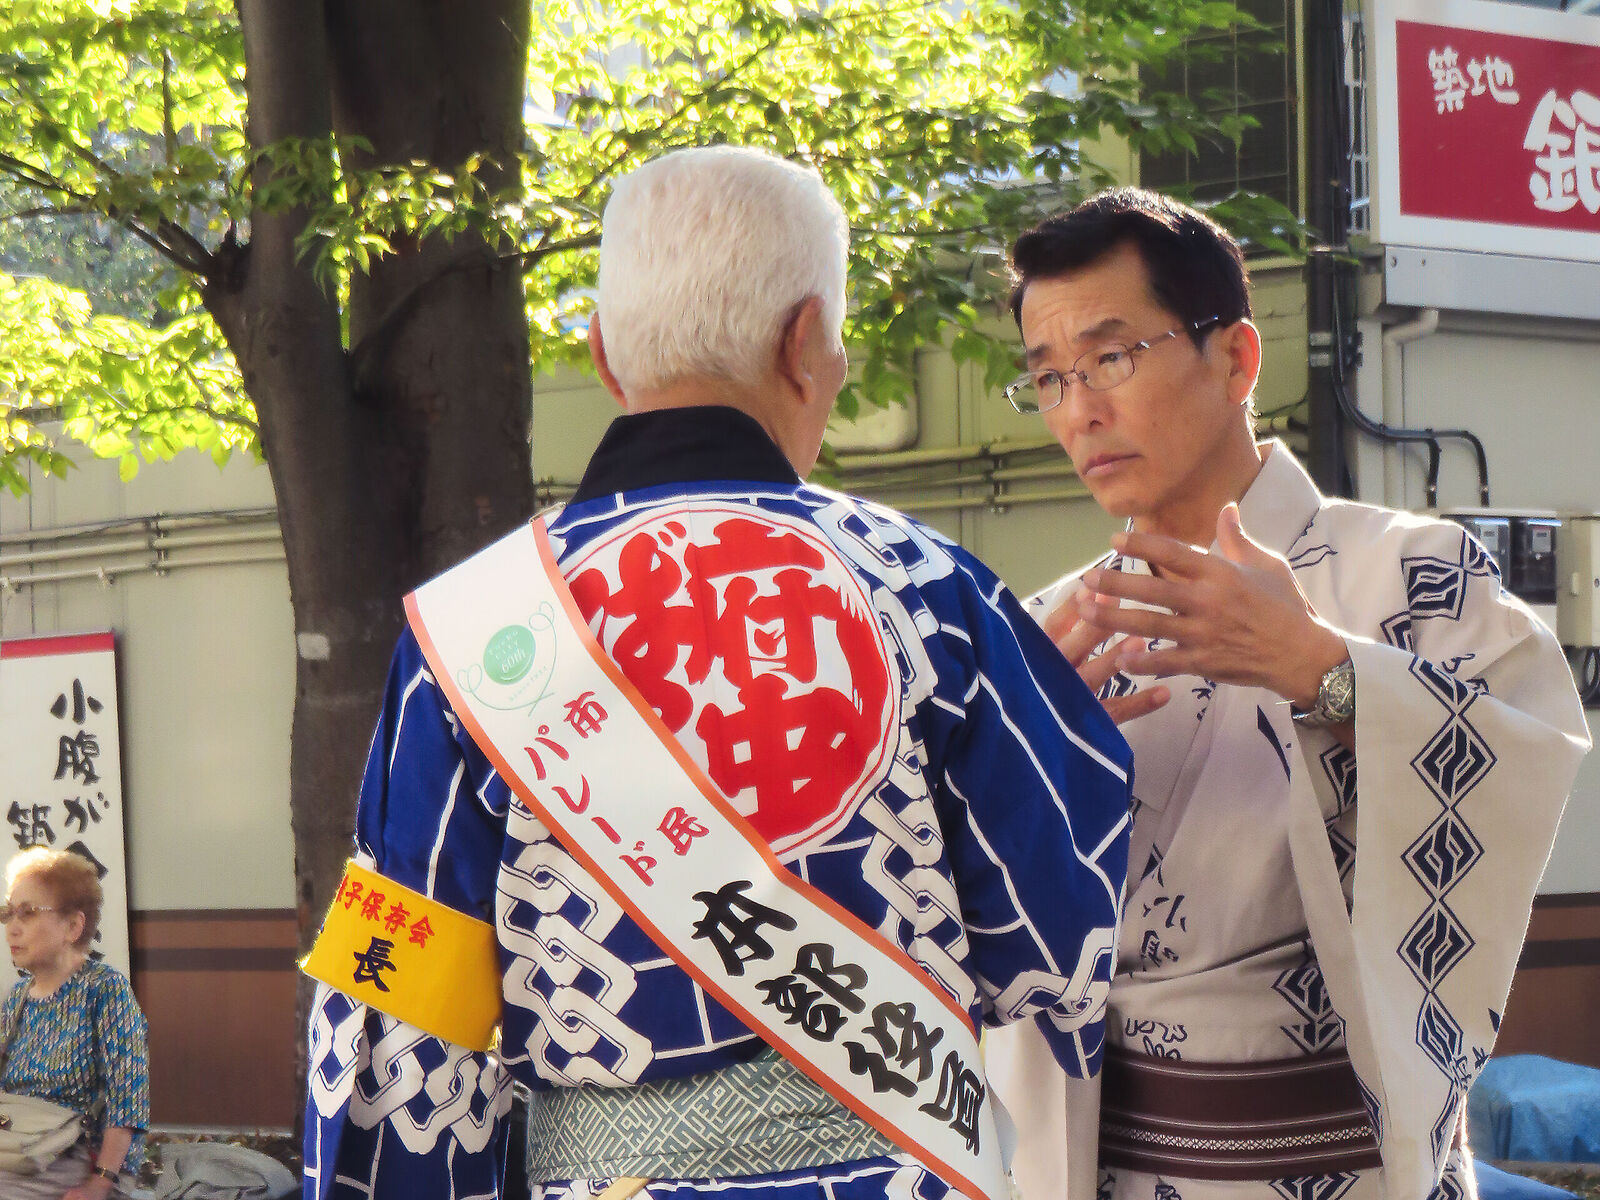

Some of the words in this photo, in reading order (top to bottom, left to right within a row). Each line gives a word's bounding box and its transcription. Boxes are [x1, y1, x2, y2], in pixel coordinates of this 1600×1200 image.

[1428, 46, 1520, 114] 築地
[524, 724, 658, 887] パレード
[336, 874, 435, 949] 子保存会
[353, 936, 398, 992] 長
[691, 879, 986, 1156] 本部役員
